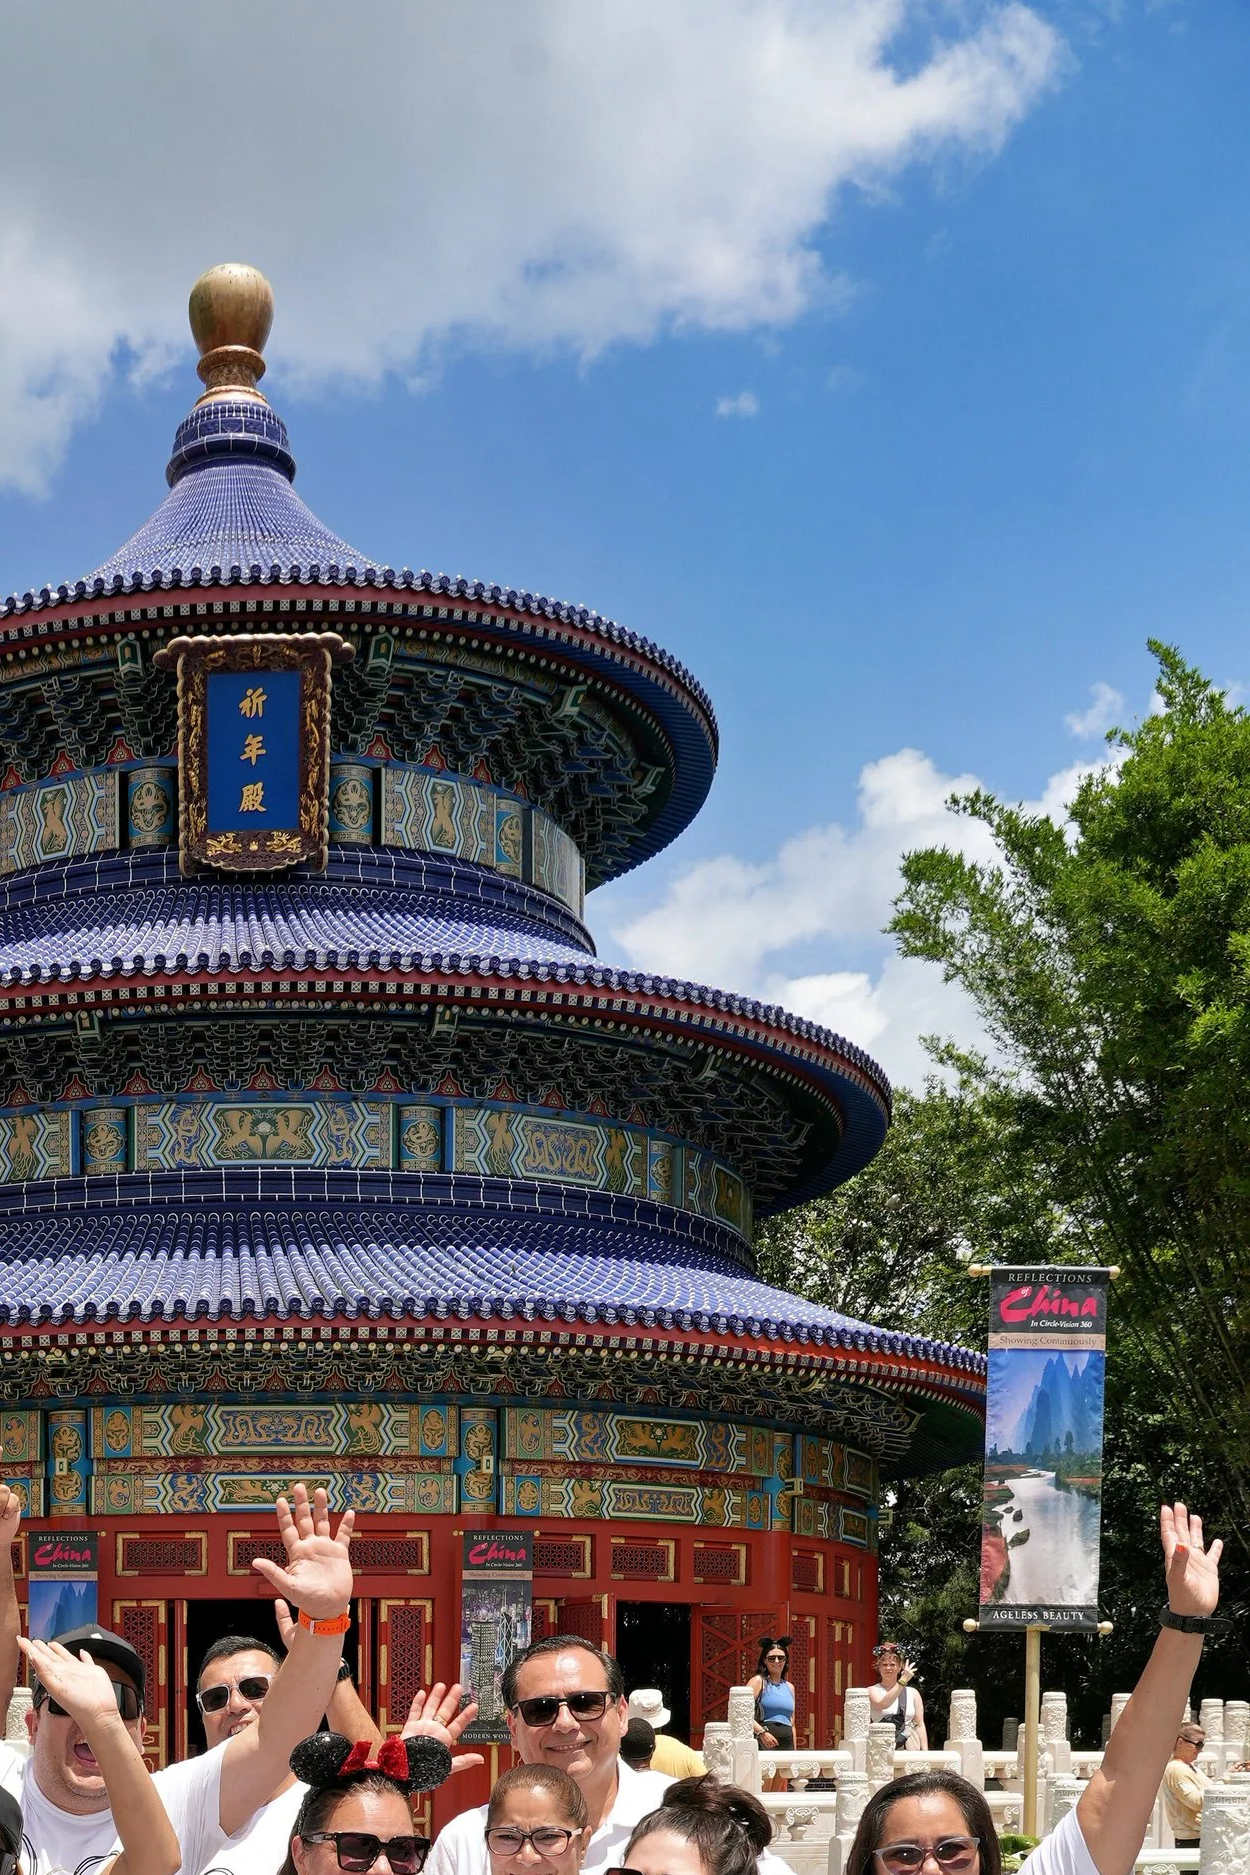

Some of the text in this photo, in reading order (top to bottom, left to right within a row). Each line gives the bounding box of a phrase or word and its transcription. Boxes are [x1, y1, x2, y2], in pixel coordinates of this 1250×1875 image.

[239, 687, 267, 813] 祈年殿
[1008, 1273, 1093, 1283] REFLECTIONS
[999, 1284, 1098, 1323] China
[1039, 1319, 1079, 1328] Circle-Vision
[999, 1335, 1097, 1346] Showing Continuously
[34, 1543, 92, 1566] China
[469, 1542, 526, 1565] China
[992, 1610, 1085, 1620] AGELESS BEAUTY
